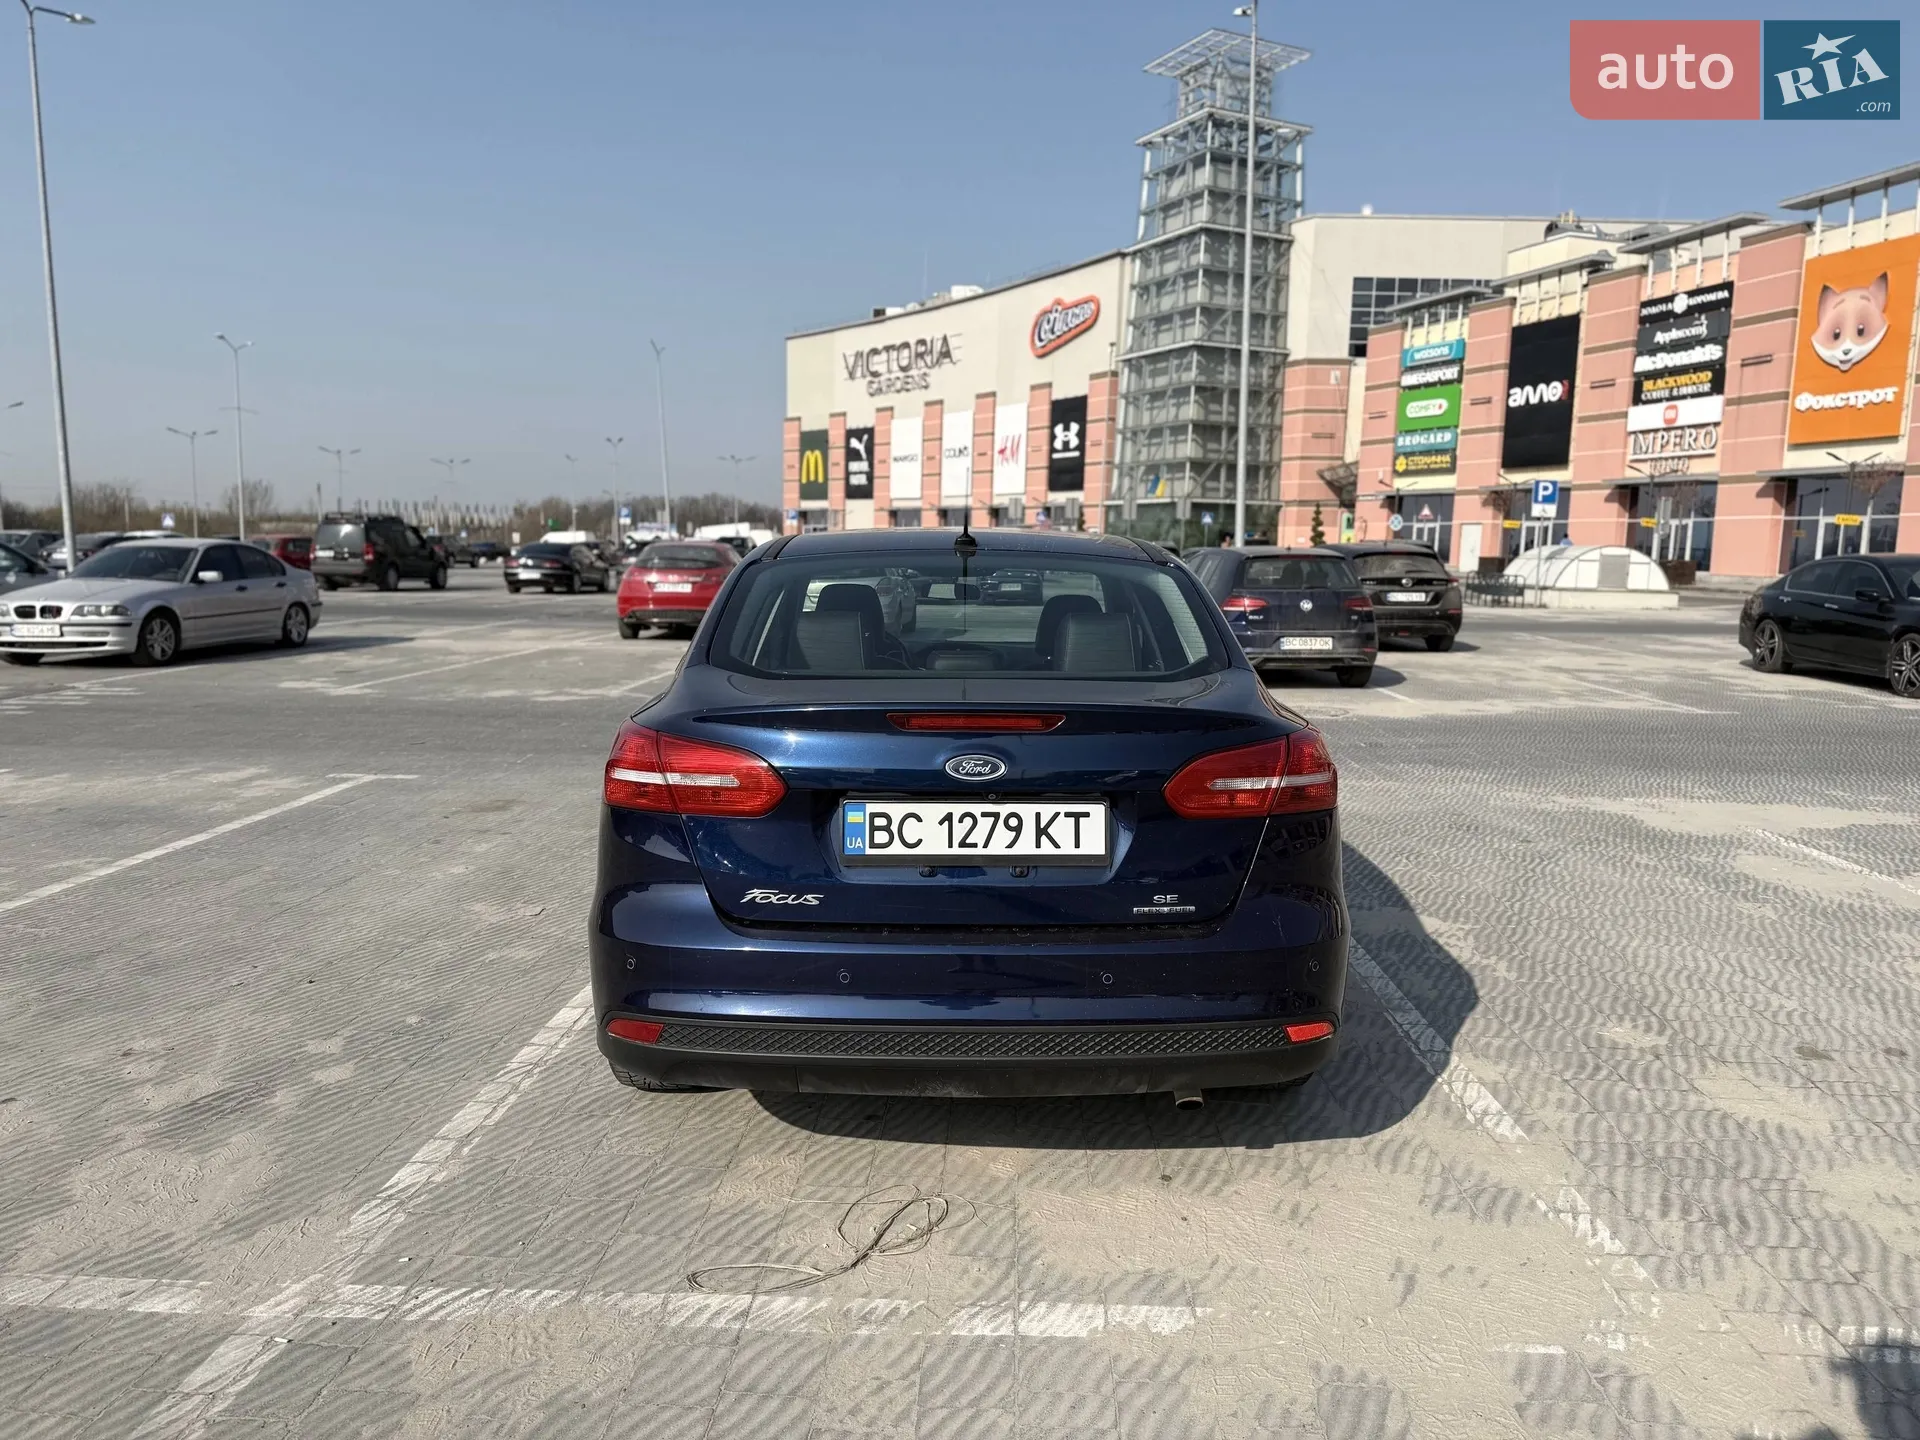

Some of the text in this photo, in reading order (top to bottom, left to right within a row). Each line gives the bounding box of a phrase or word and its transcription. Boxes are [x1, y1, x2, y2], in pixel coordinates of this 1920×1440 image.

[843, 334, 956, 381] VICTORIA
[1633, 344, 1723, 373] McDonald's
[867, 372, 930, 397] GARDENS
[1643, 371, 1713, 392] BLACKWOOD
[1794, 386, 1899, 412] Фокстрот
[1630, 425, 1717, 456] IMPERO
[1537, 482, 1553, 502] P
[959, 760, 991, 774] Ford
[847, 837, 863, 848] UA
[868, 812, 1090, 849] BC 1279 KT
[1153, 894, 1179, 904] SE
